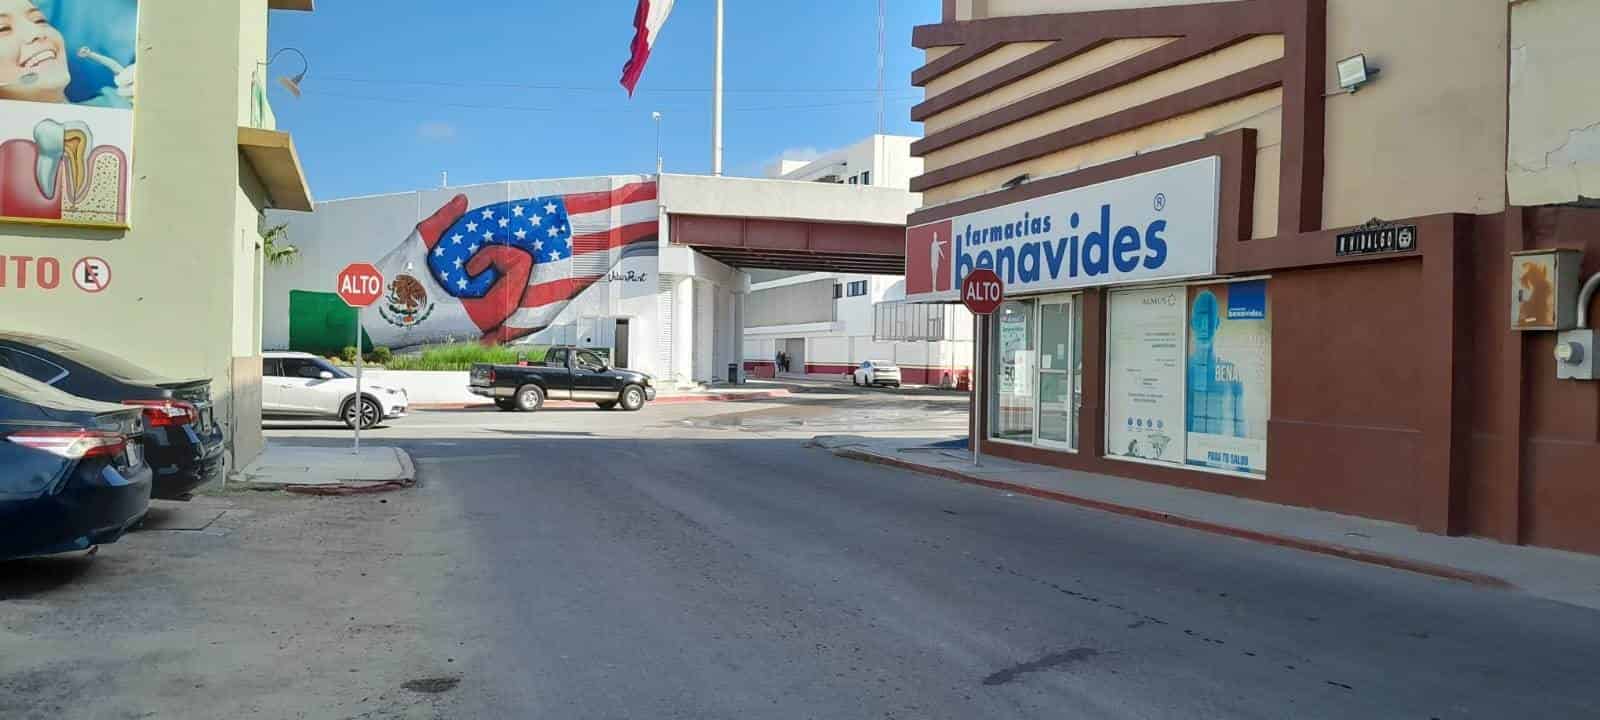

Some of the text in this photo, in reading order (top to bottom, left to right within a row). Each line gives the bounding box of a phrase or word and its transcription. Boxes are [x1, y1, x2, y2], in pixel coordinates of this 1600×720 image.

[965, 212, 1052, 247] farmacias
[954, 203, 1168, 290] benavides
[341, 274, 380, 295] ALTO
[966, 281, 1000, 302] ALTO
